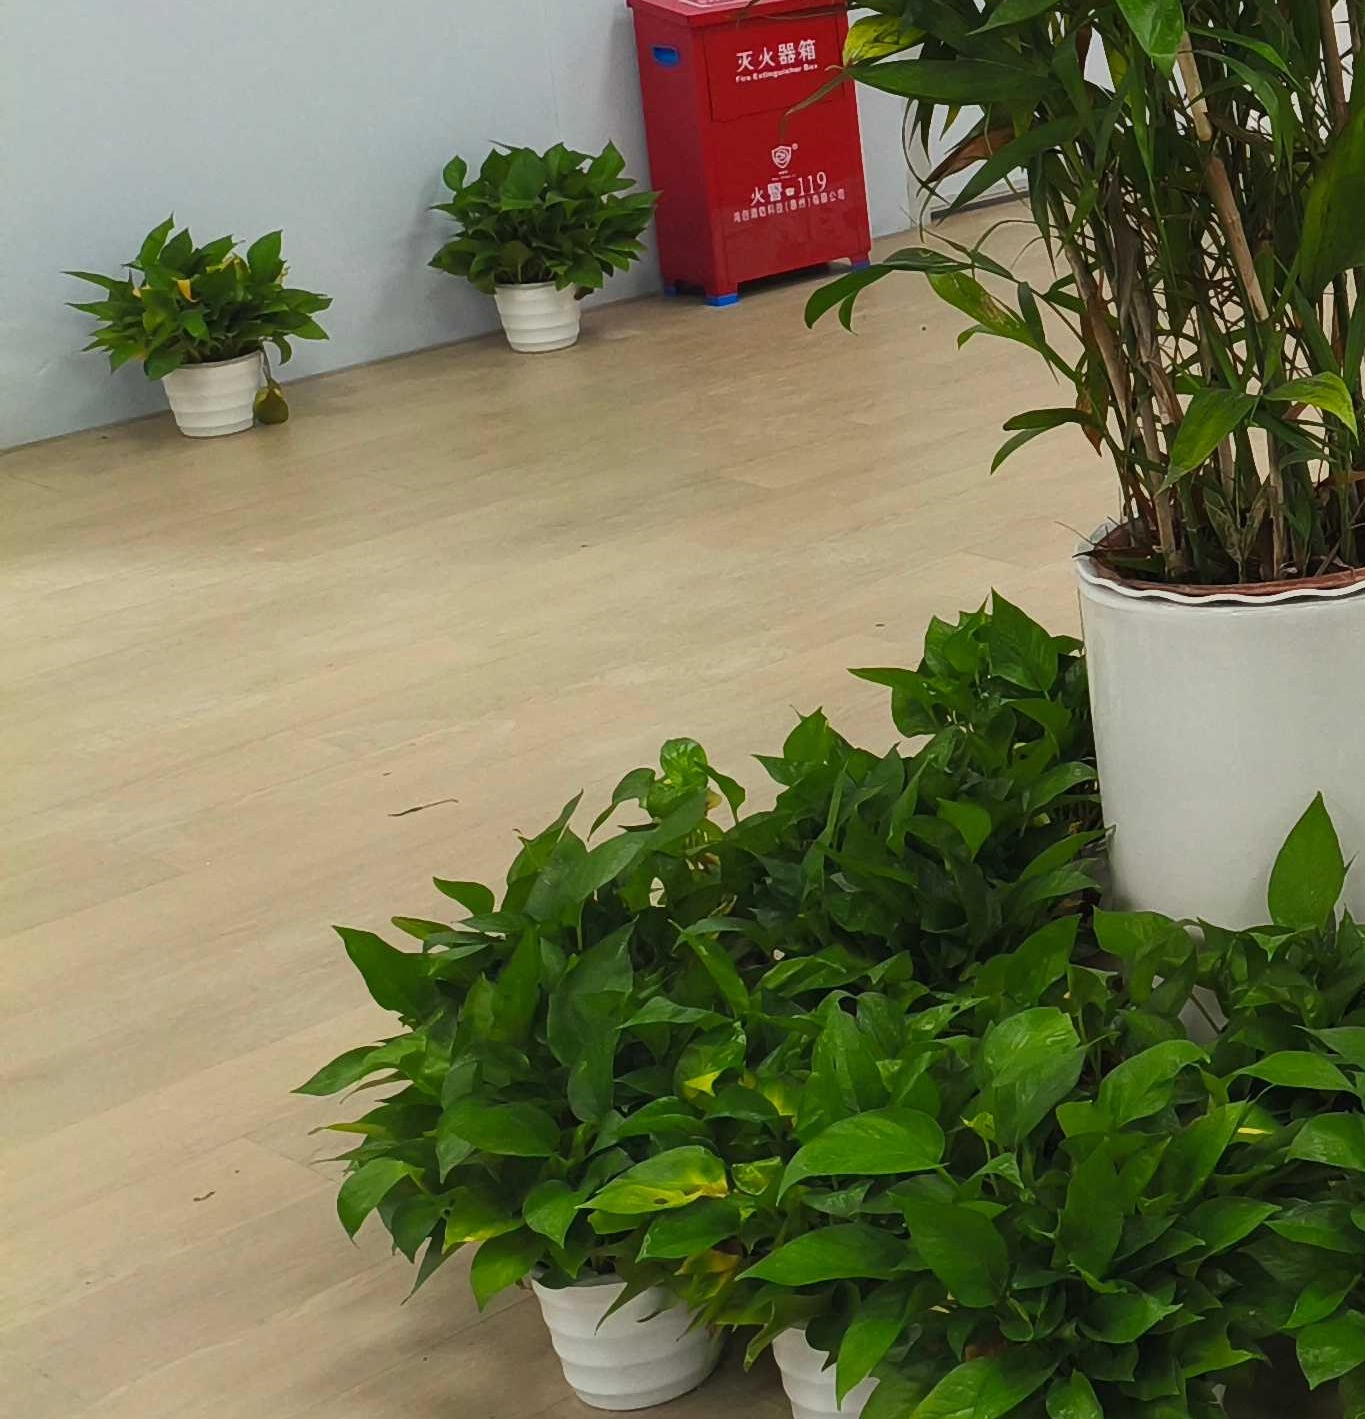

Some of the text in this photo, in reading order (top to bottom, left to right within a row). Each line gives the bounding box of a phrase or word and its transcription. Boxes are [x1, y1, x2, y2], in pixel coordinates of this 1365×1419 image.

[736, 39, 817, 72] 灭火器箱
[797, 171, 828, 197] 119
